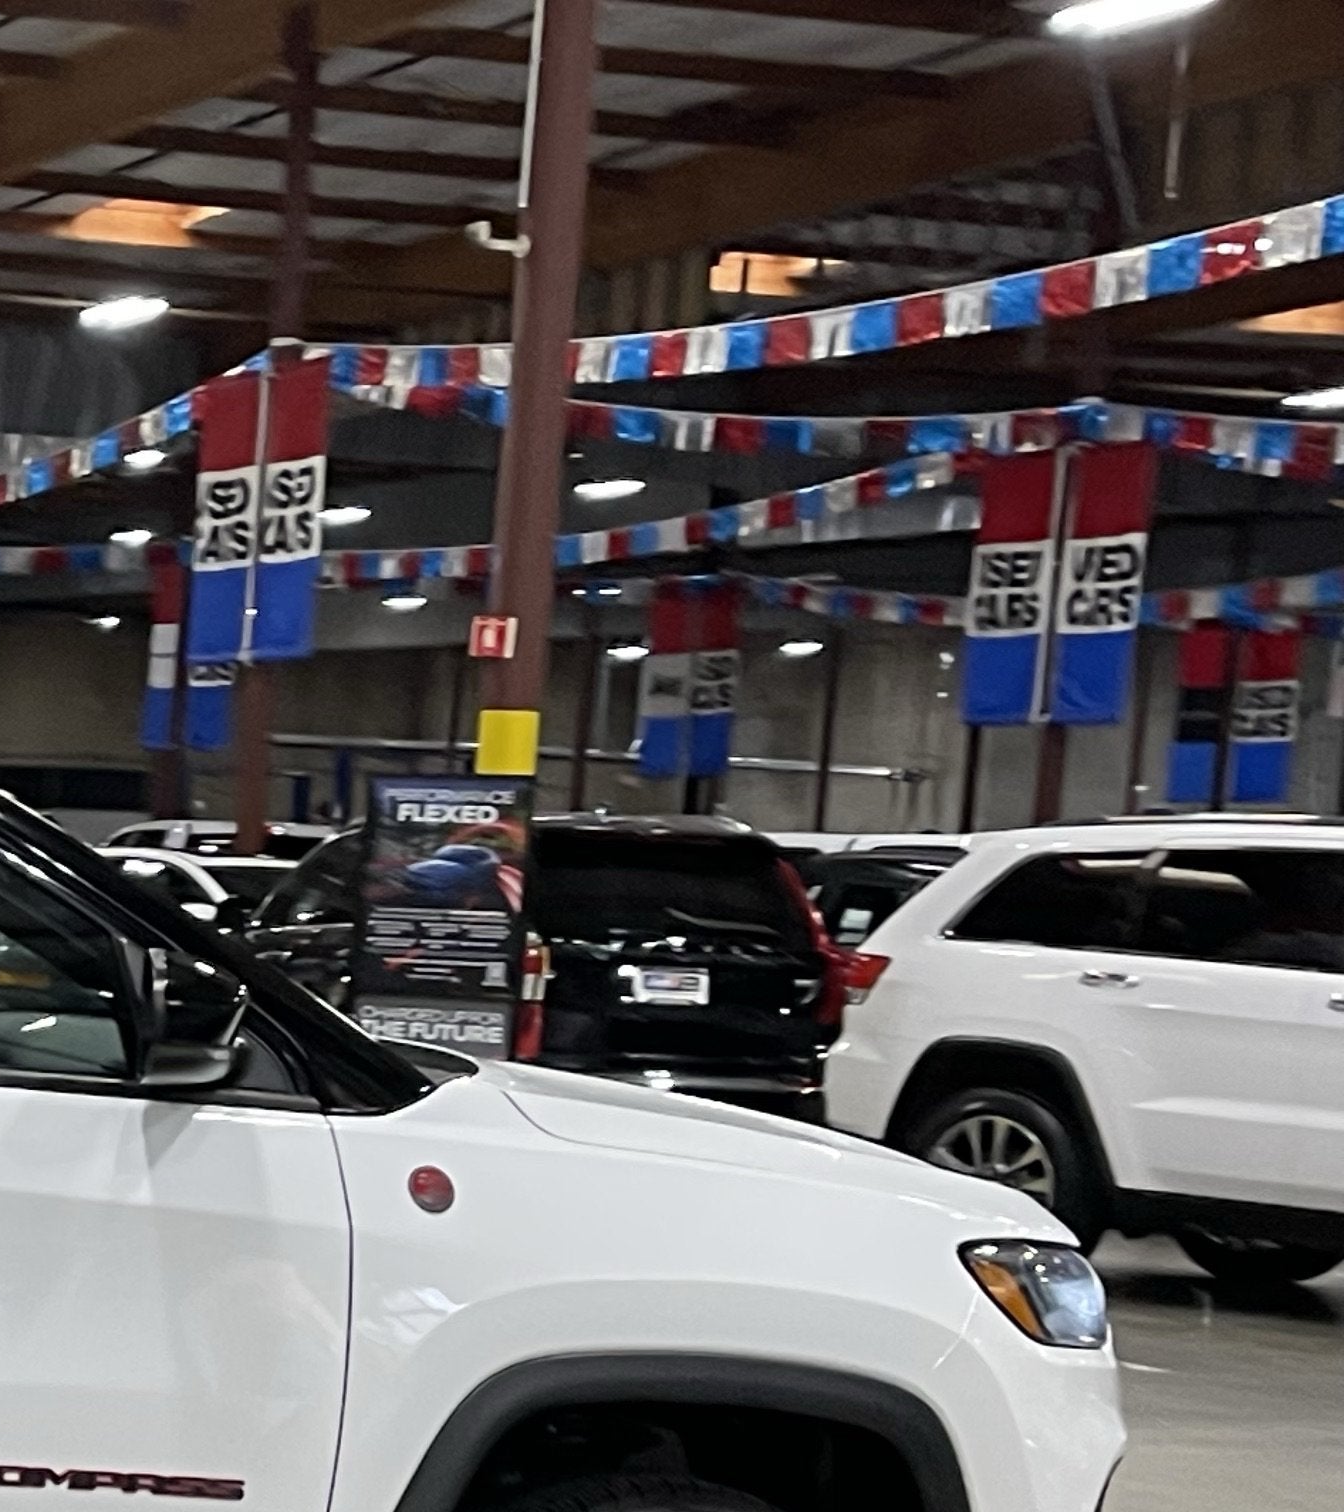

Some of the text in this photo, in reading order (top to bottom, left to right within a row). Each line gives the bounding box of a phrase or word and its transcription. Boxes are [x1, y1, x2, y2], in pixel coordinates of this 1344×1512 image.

[396, 803, 499, 824] FLEXED
[361, 1019, 504, 1044] THE FUTURE
